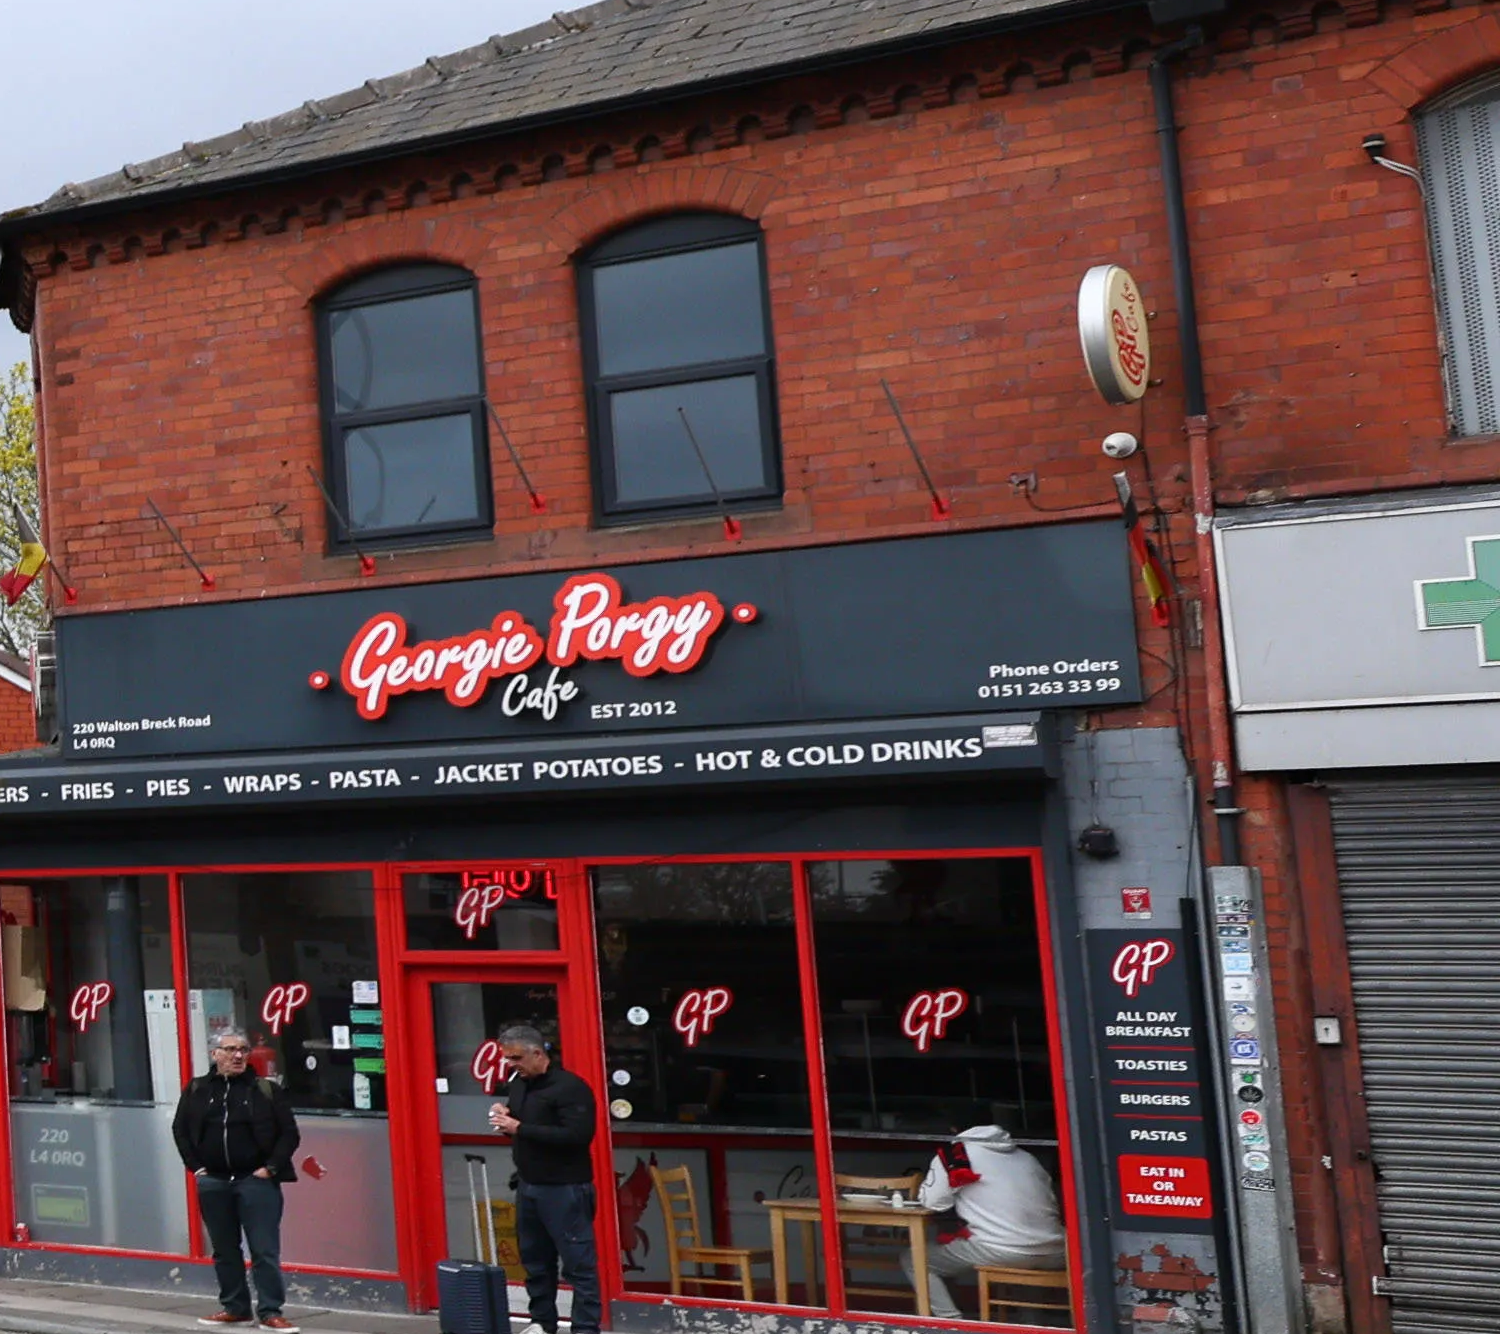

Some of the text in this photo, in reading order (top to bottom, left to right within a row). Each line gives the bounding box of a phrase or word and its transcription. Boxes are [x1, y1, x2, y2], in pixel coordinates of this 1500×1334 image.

[349, 581, 713, 712] Georgie Porgy
[989, 658, 1120, 679] Phone Orders
[502, 668, 578, 721] Cafe
[979, 678, 1121, 700] 0151 263 33 99
[591, 700, 677, 719] EST 2012
[73, 715, 211, 735] 220 Walton Breck Road
[73, 737, 89, 749] L4
[61, 782, 115, 801] FRIES
[146, 779, 190, 798] PIES
[224, 773, 301, 794] WRAPS
[329, 769, 401, 789] PASTA
[434, 762, 523, 784] JACKET
[532, 755, 663, 781] POTATOES
[695, 750, 752, 771] HOT
[760, 748, 782, 768] &
[787, 743, 864, 769] COLD
[872, 738, 983, 763] DRINKS
[1112, 940, 1170, 996] GP
[71, 981, 112, 1031] GP
[262, 982, 308, 1034] GP
[676, 988, 729, 1045] GP
[903, 989, 967, 1051] GP
[1117, 1011, 1177, 1023] ALL DAY
[1105, 1026, 1191, 1038] BREAKFAST
[1115, 1059, 1188, 1071] TOASTIES
[1120, 1094, 1190, 1106] BURGERS
[39, 1128, 69, 1143] 220
[1130, 1130, 1188, 1142] PASTAS
[30, 1149, 48, 1163] L4
[1140, 1167, 1184, 1178] EAT IN
[1153, 1182, 1175, 1191] OR
[1126, 1194, 1203, 1207] TAKEAWAY
